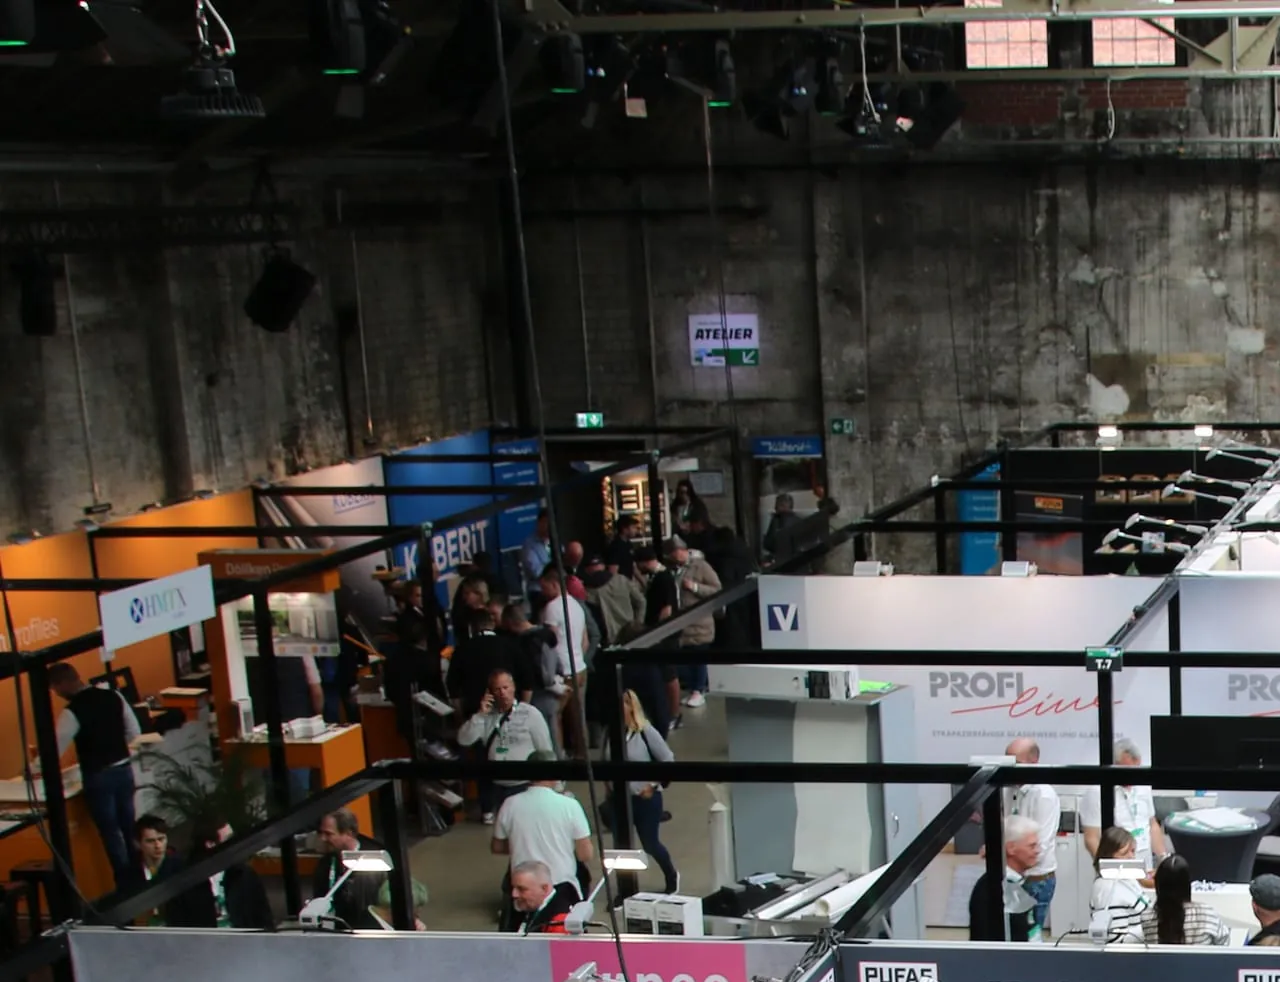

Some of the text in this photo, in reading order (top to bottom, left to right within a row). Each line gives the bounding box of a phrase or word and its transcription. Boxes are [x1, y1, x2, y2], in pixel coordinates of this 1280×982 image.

[695, 328, 753, 340] ATELIER
[403, 519, 490, 581] KBERiT
[15, 617, 59, 646] rofiles
[1095, 659, 1113, 670] T.7
[929, 672, 1024, 698] PROFI
